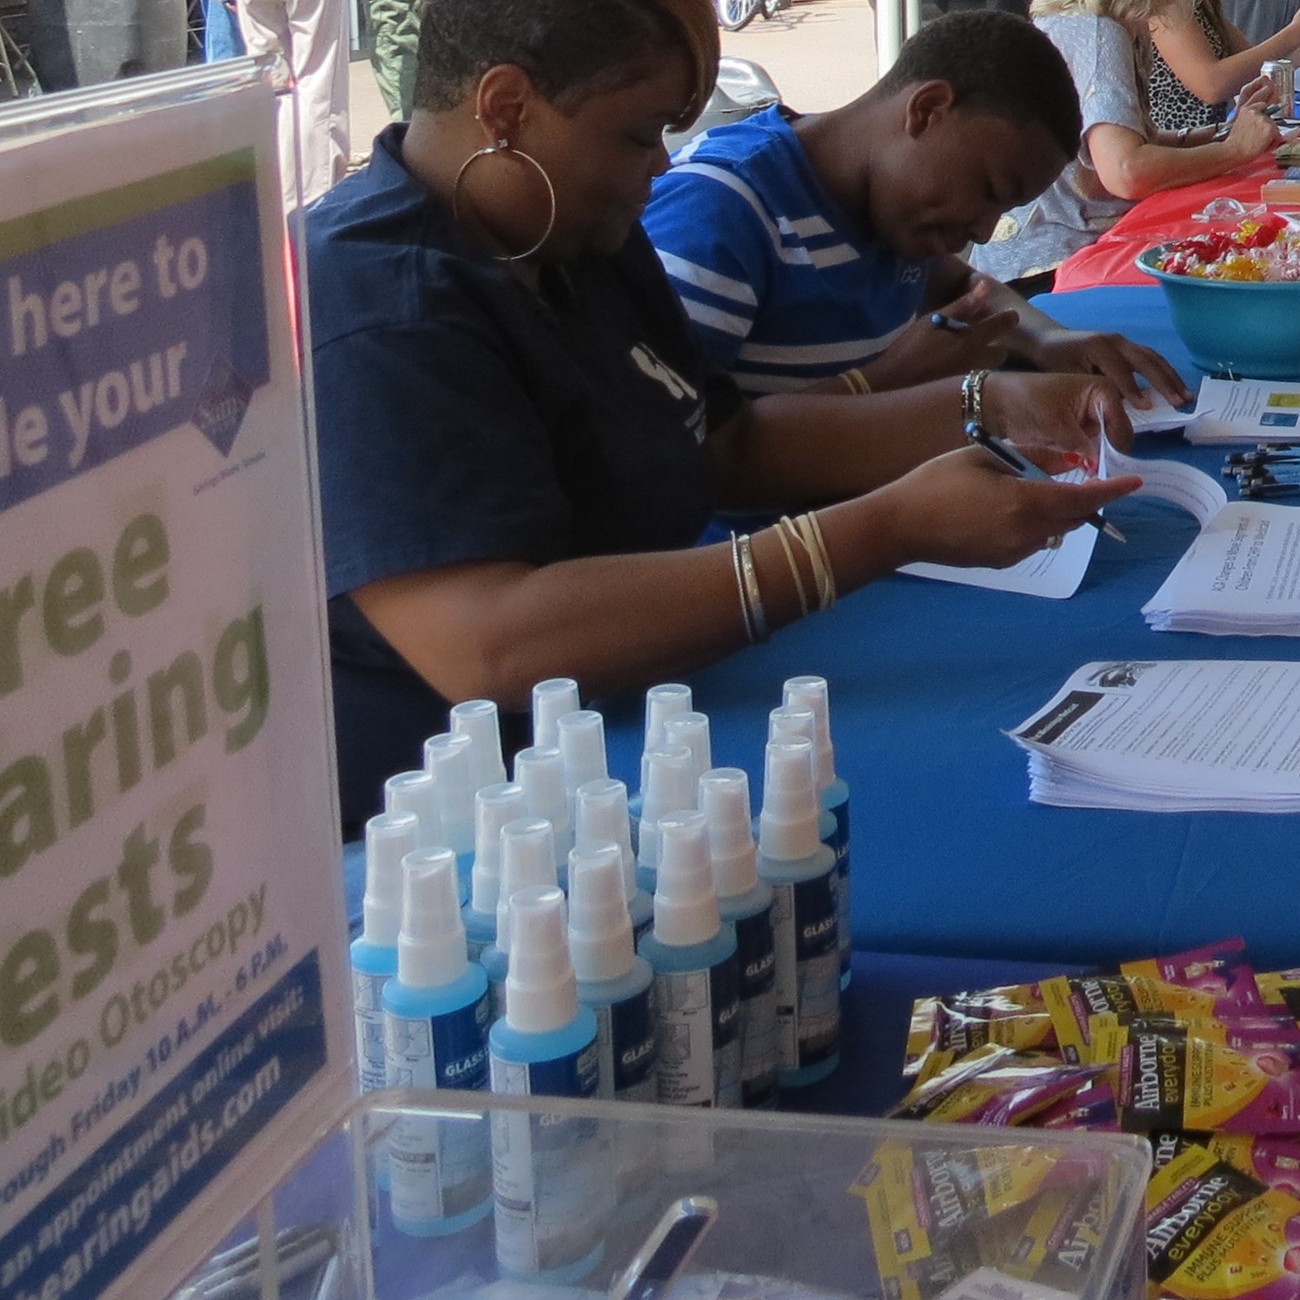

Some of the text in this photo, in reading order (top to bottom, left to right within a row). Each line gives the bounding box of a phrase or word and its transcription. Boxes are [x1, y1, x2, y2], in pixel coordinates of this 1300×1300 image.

[8, 234, 208, 357] here to
[58, 341, 188, 470] your
[0, 513, 171, 695] ree
[0, 603, 271, 879] aring
[0, 803, 214, 1048] ests
[101, 880, 267, 1049] Otoscopy
[72, 1066, 141, 1141] Friday
[146, 1036, 172, 1071] 10
[235, 966, 248, 992] 6
[1134, 1034, 1160, 1110] Airborne
[18, 1056, 280, 1300] earingaids.com
[38, 1093, 189, 1251] appointment
[191, 1032, 254, 1104] online
[1145, 1175, 1228, 1259] Airborne
[1166, 1186, 1239, 1259] everyday
[1183, 1230, 1227, 1276] IMMUNE
